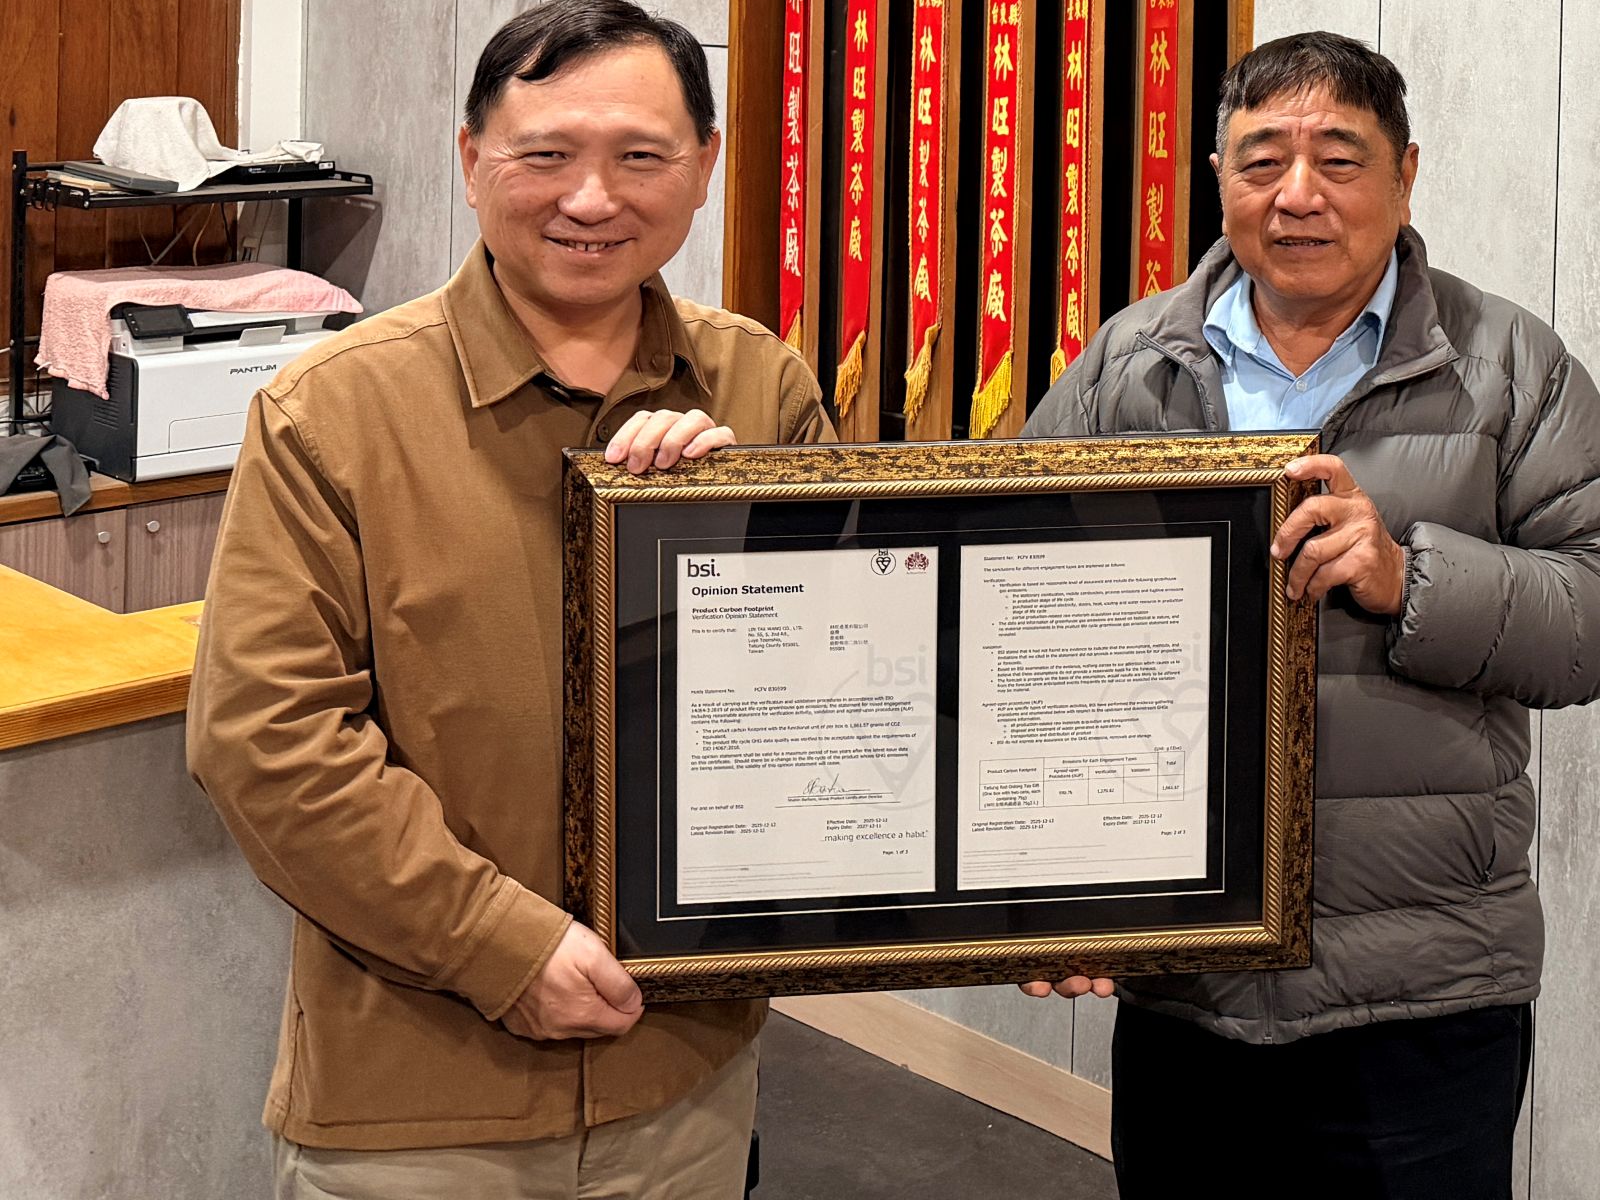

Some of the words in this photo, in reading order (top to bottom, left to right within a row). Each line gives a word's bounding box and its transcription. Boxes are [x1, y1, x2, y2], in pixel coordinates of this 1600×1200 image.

[848, 9, 869, 262] 林旺製茶廠
[984, 33, 1014, 322] 林旺製茶廠
[687, 558, 721, 578] bsi.
[691, 585, 738, 598] Opinion
[741, 583, 805, 595] Statement
[692, 607, 718, 615] Product
[719, 606, 742, 614] Carbon
[744, 605, 775, 615] Footprint
[855, 832, 896, 841] excellence
